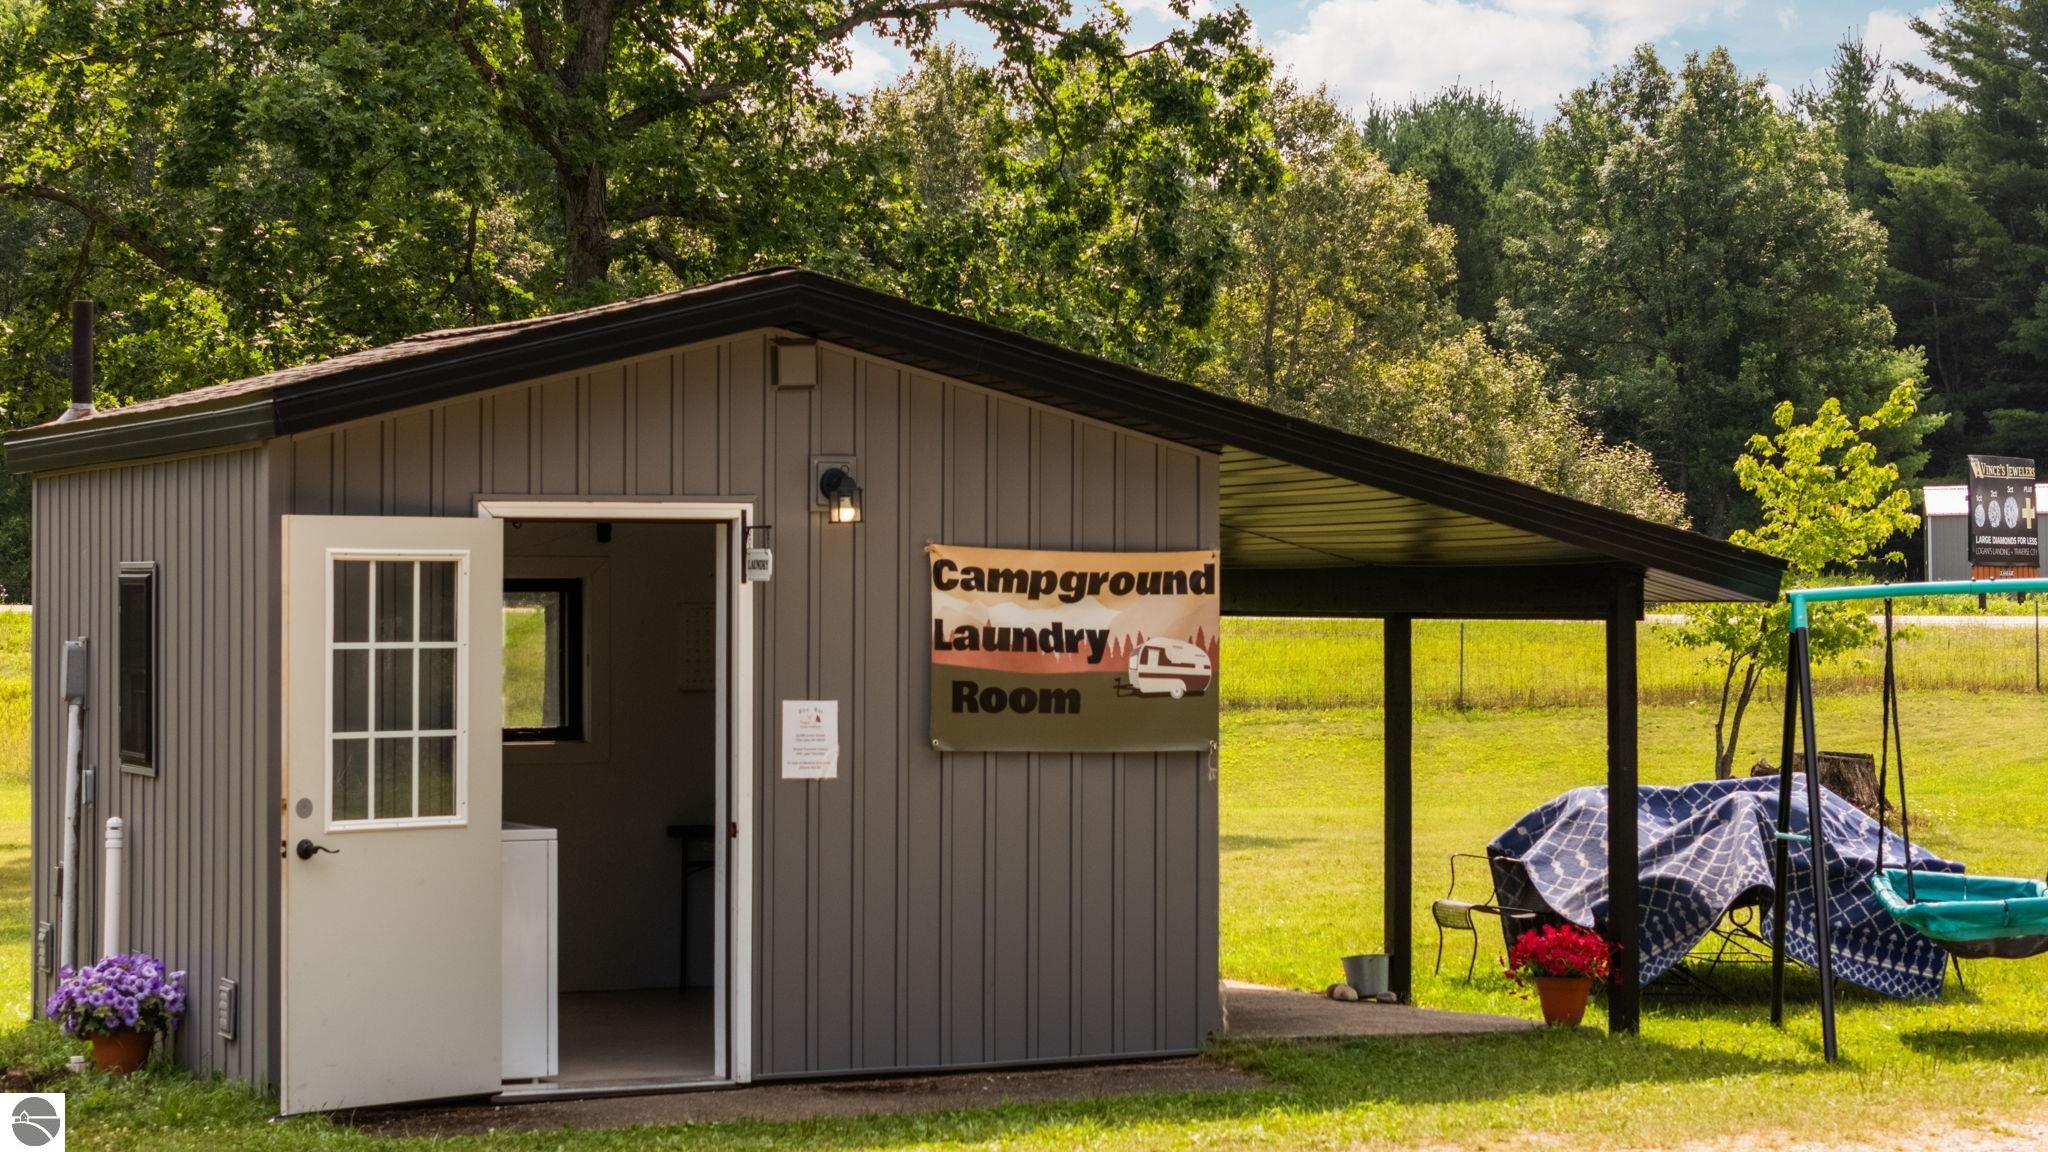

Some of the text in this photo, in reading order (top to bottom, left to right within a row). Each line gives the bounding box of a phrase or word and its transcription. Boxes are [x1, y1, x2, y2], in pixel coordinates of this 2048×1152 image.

[2006, 464, 2036, 479] JEWELERS
[1975, 535, 2038, 546] LARGE DIAMONDS FOR LESS
[748, 559, 769, 571] LAUNDRY
[932, 558, 1216, 604] Campground
[934, 618, 1110, 664] Laundry
[952, 680, 1081, 714] Room
